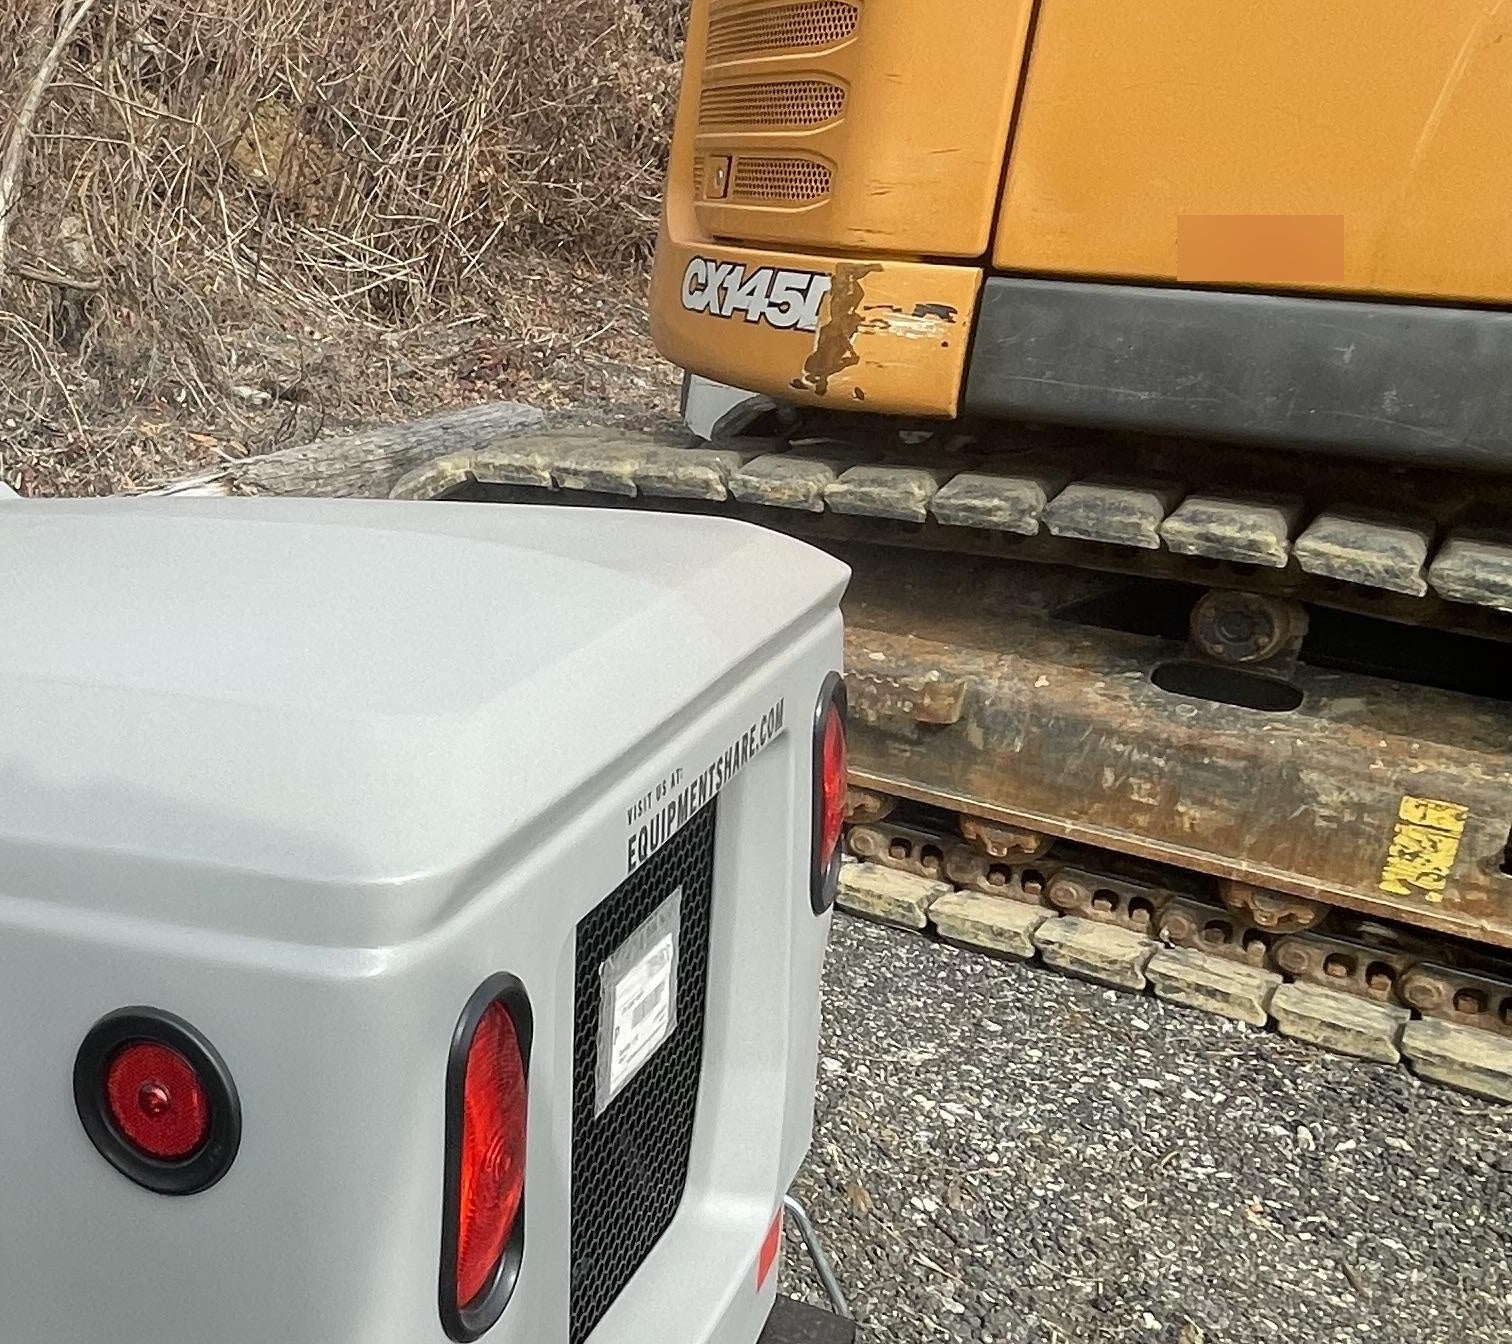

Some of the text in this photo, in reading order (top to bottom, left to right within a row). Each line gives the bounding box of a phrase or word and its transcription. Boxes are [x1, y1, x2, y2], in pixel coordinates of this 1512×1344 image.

[627, 696, 785, 874] EQUIPMENTSHARE.COM
[627, 792, 652, 825] VISIT
[655, 779, 667, 802] US
